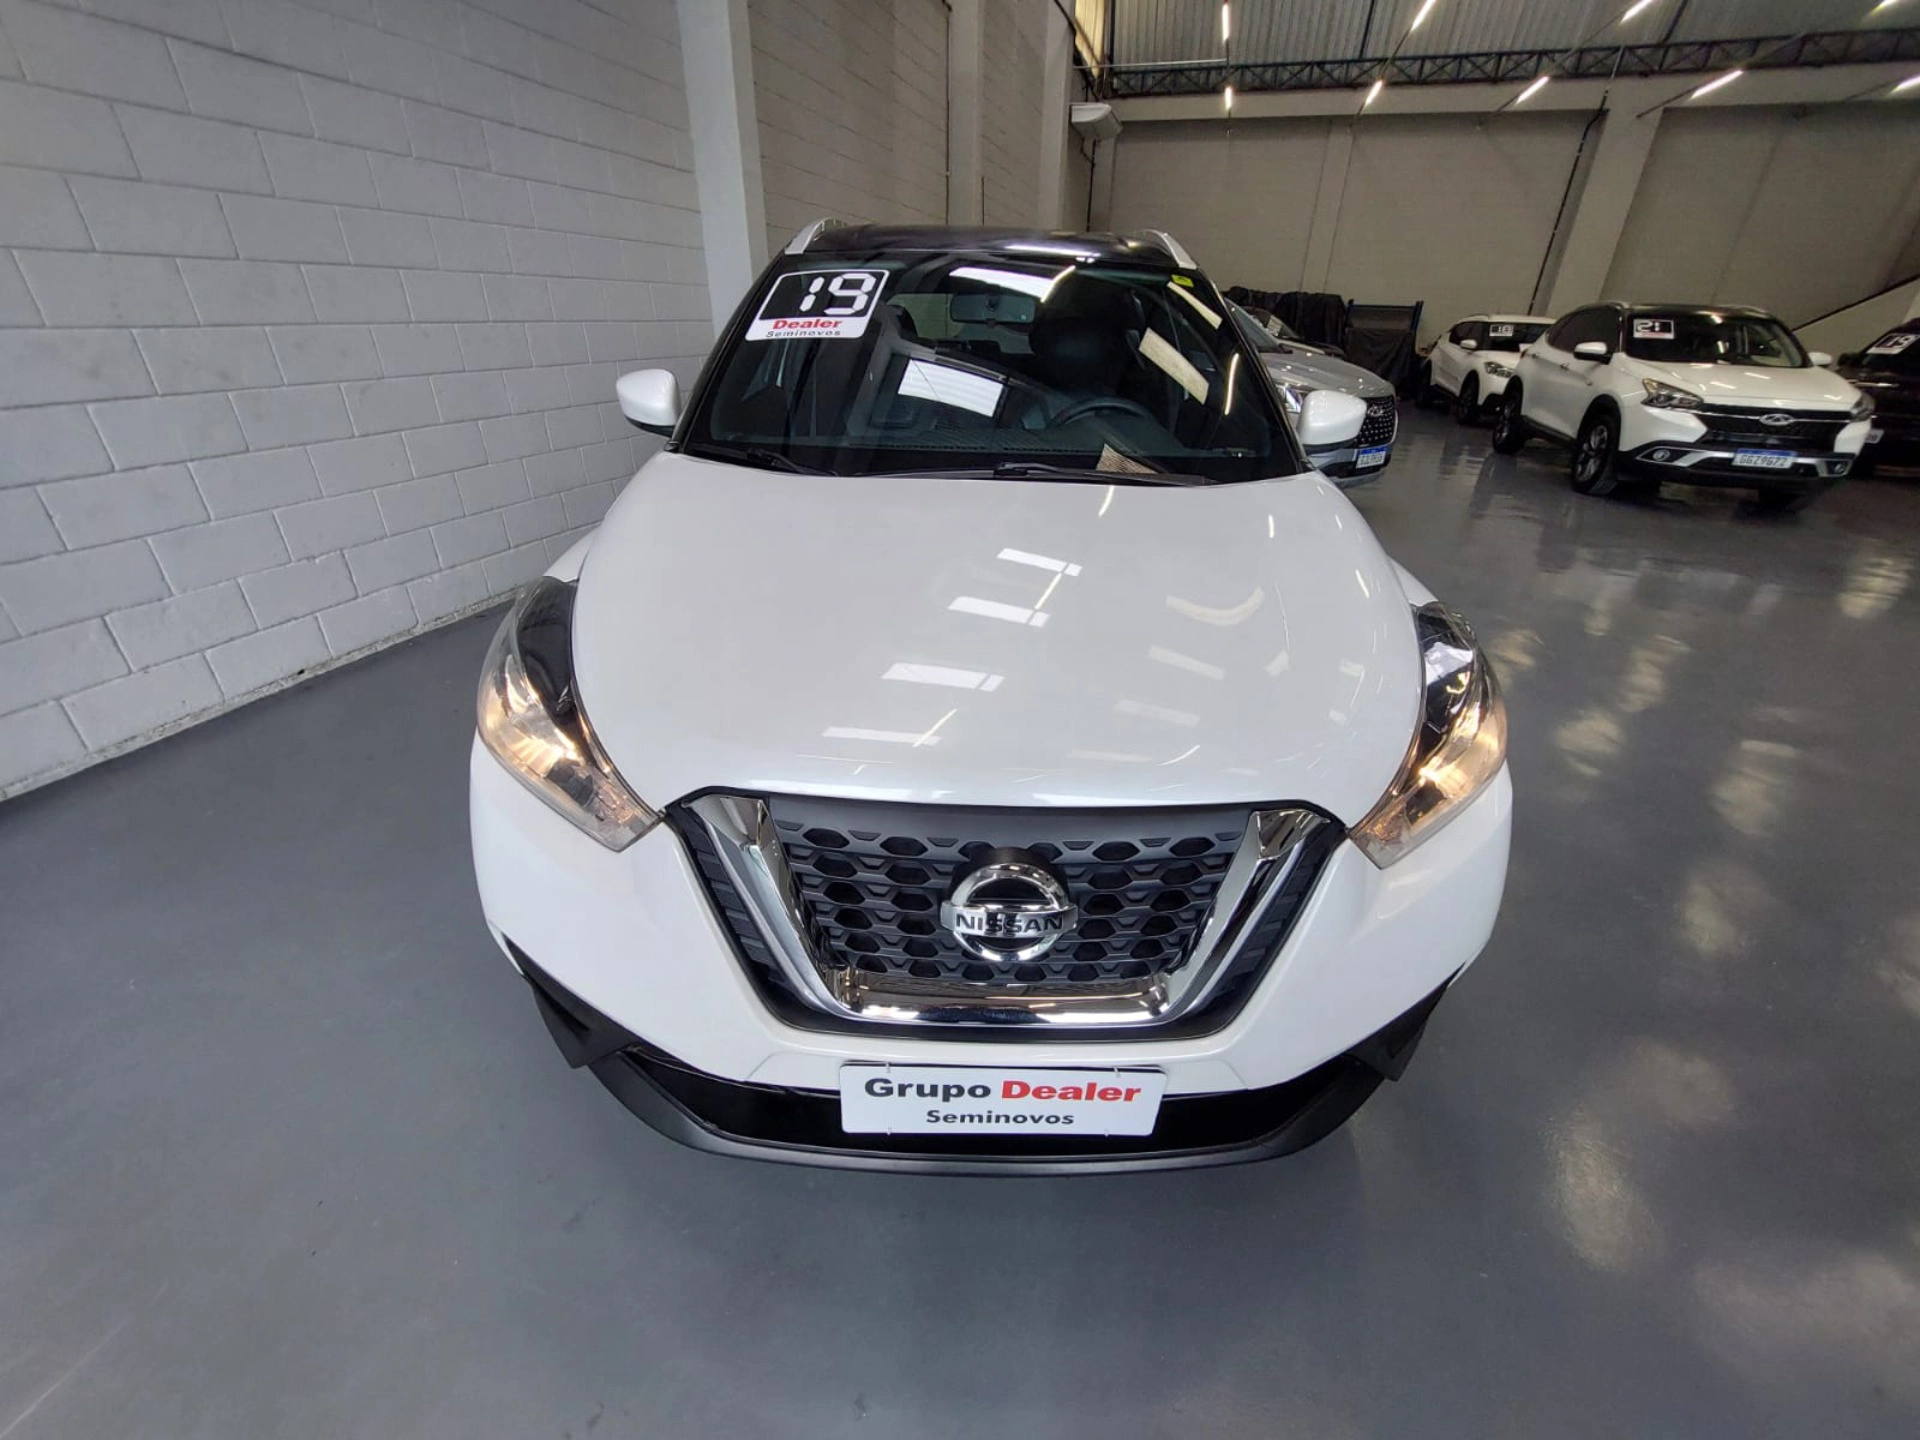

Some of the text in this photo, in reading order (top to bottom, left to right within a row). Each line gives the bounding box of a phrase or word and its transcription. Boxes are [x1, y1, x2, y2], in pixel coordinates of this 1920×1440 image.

[800, 273, 876, 315] 19
[773, 319, 842, 329] Dealer
[1637, 320, 1660, 331] 21
[956, 913, 1062, 933] NISSAN
[864, 1078, 1141, 1102] Grupo Dealer
[926, 1110, 1074, 1125] Seminovos
